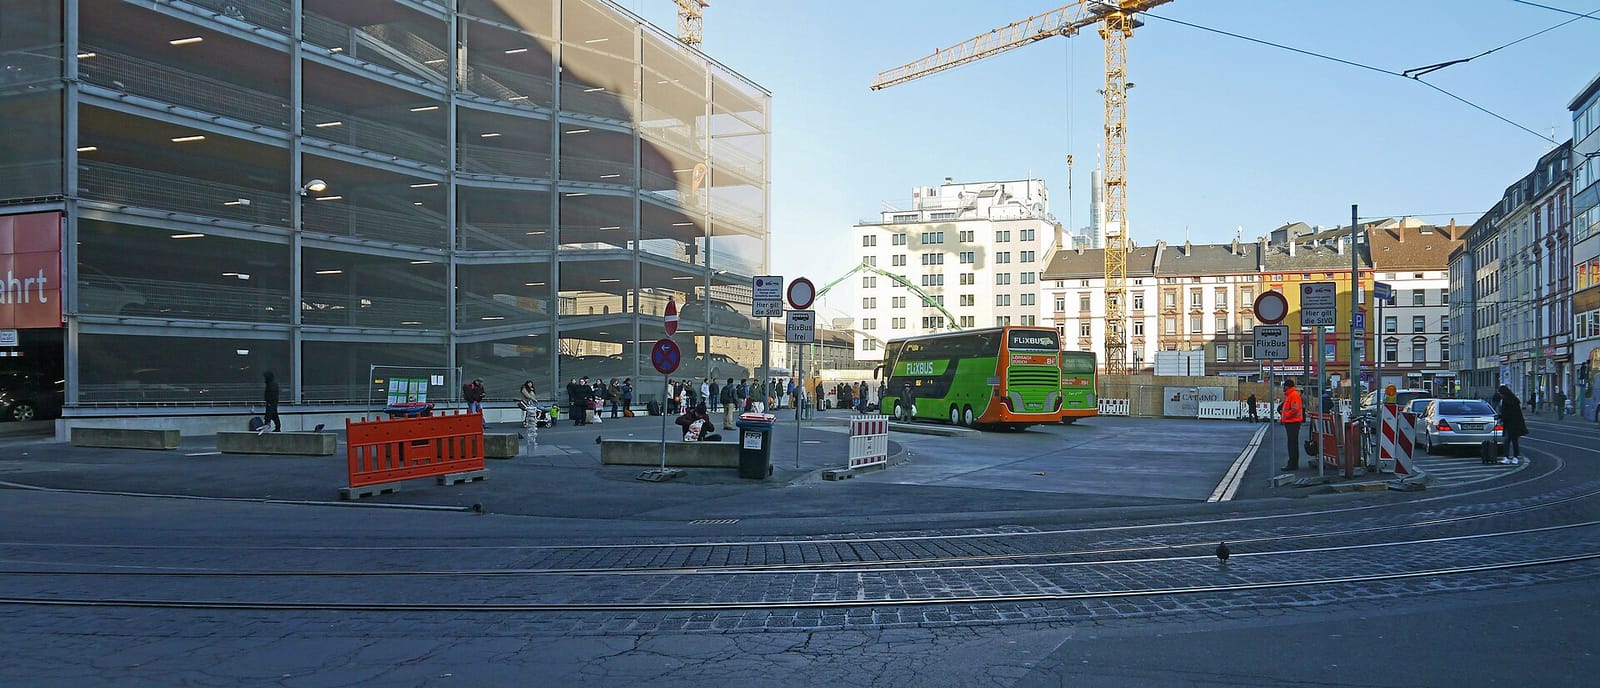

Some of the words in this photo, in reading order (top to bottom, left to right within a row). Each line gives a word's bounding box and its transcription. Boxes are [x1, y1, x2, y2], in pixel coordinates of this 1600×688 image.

[1321, 310, 1332, 318] gilt
[1256, 340, 1286, 348] FlixBus
[1264, 349, 1278, 357] frei
